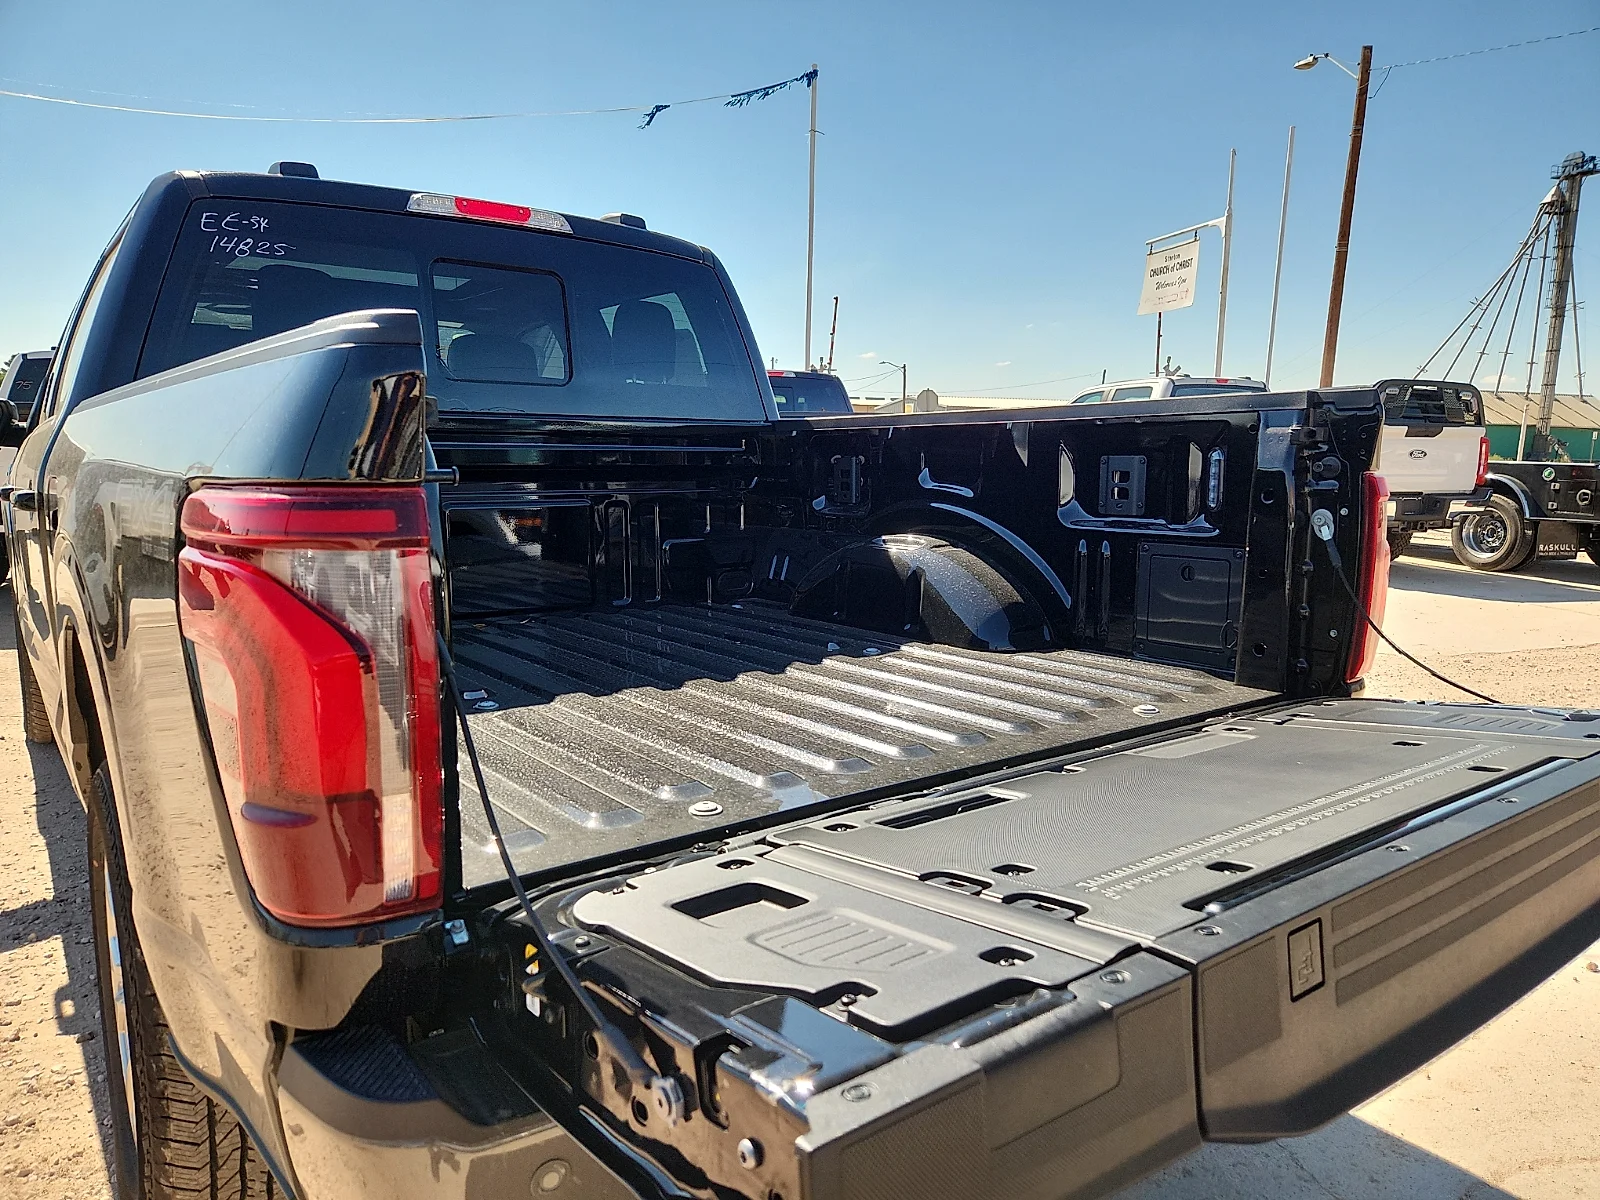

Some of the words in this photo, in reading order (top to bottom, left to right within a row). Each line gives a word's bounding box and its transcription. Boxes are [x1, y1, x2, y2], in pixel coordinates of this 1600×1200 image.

[210, 236, 296, 257] 14825
[1149, 264, 1170, 278] CHURCH
[1175, 257, 1194, 272] CHRIST
[15, 380, 33, 390] 75
